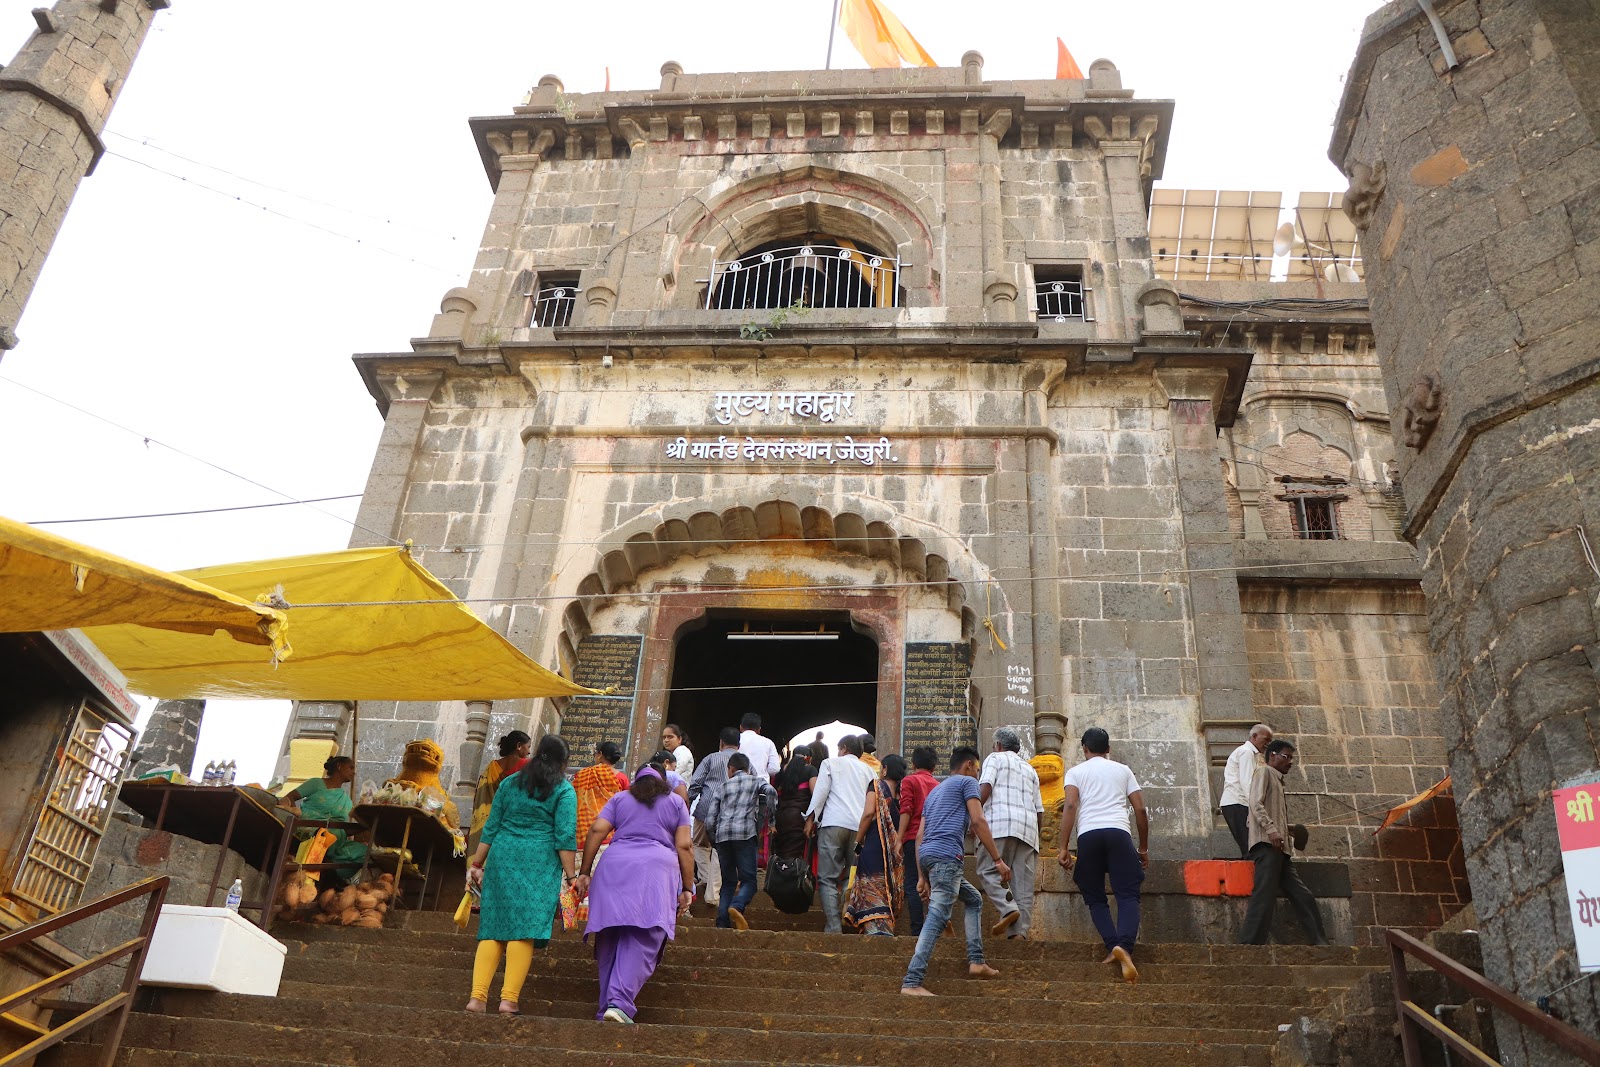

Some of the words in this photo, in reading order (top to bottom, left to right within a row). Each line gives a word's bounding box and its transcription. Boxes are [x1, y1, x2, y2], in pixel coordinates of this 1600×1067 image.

[714, 391, 773, 425] मुख्य
[777, 391, 855, 423] महाद्वार
[665, 436, 688, 460] श्री
[690, 435, 738, 460] मार्तंड
[1566, 790, 1595, 823] श्री
